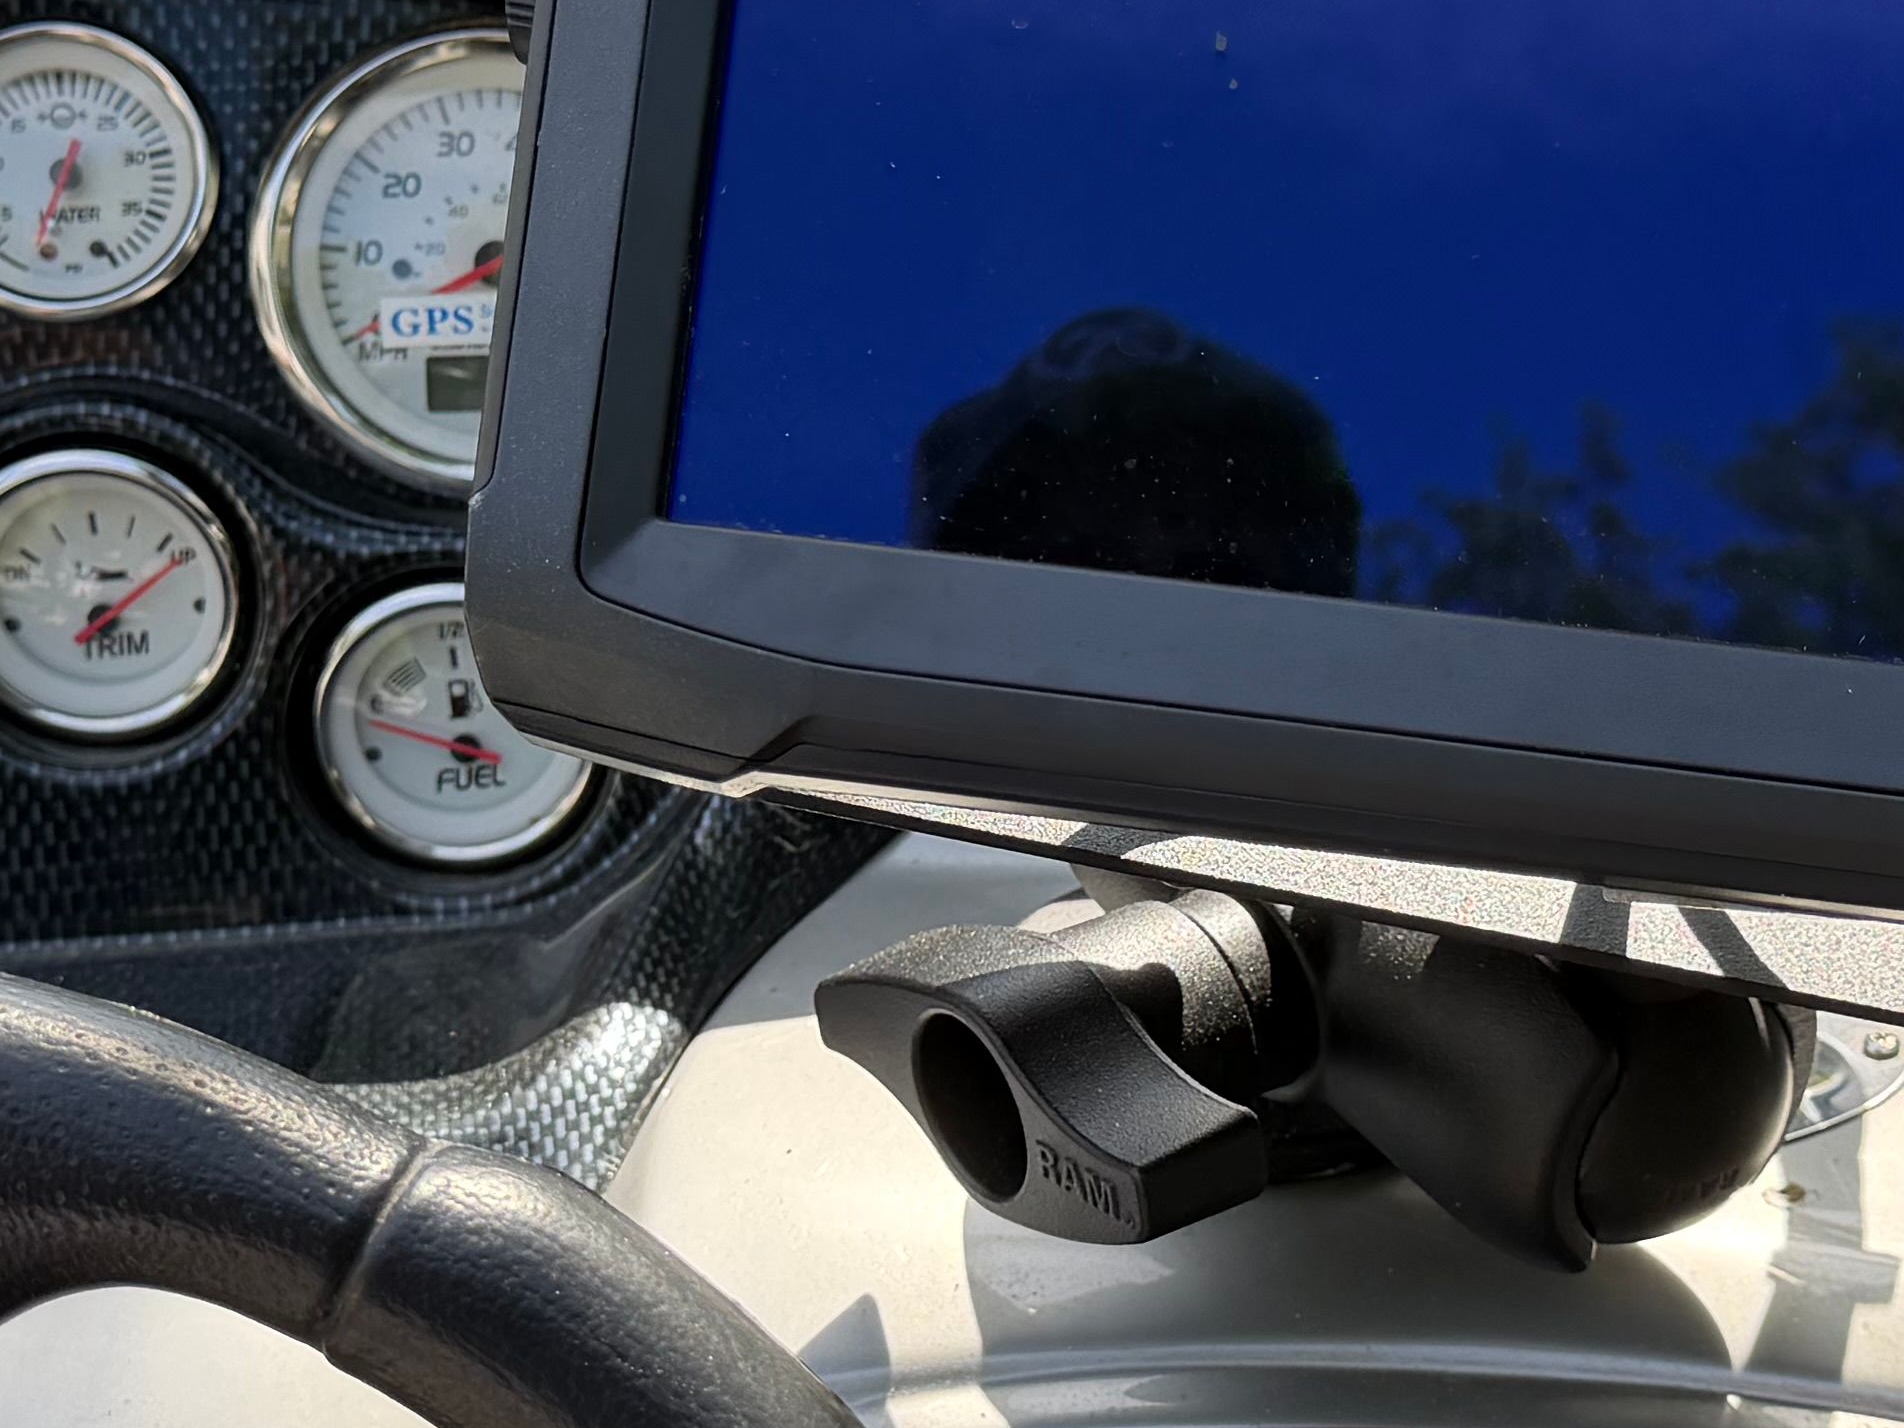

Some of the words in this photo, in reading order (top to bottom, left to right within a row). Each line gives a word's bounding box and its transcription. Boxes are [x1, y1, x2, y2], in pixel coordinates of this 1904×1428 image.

[437, 131, 476, 158] 30
[382, 172, 422, 199] 20
[355, 240, 384, 266] 10
[391, 305, 475, 338] GPS
[436, 763, 507, 794] FUEL
[1035, 1139, 1121, 1222] RAM
